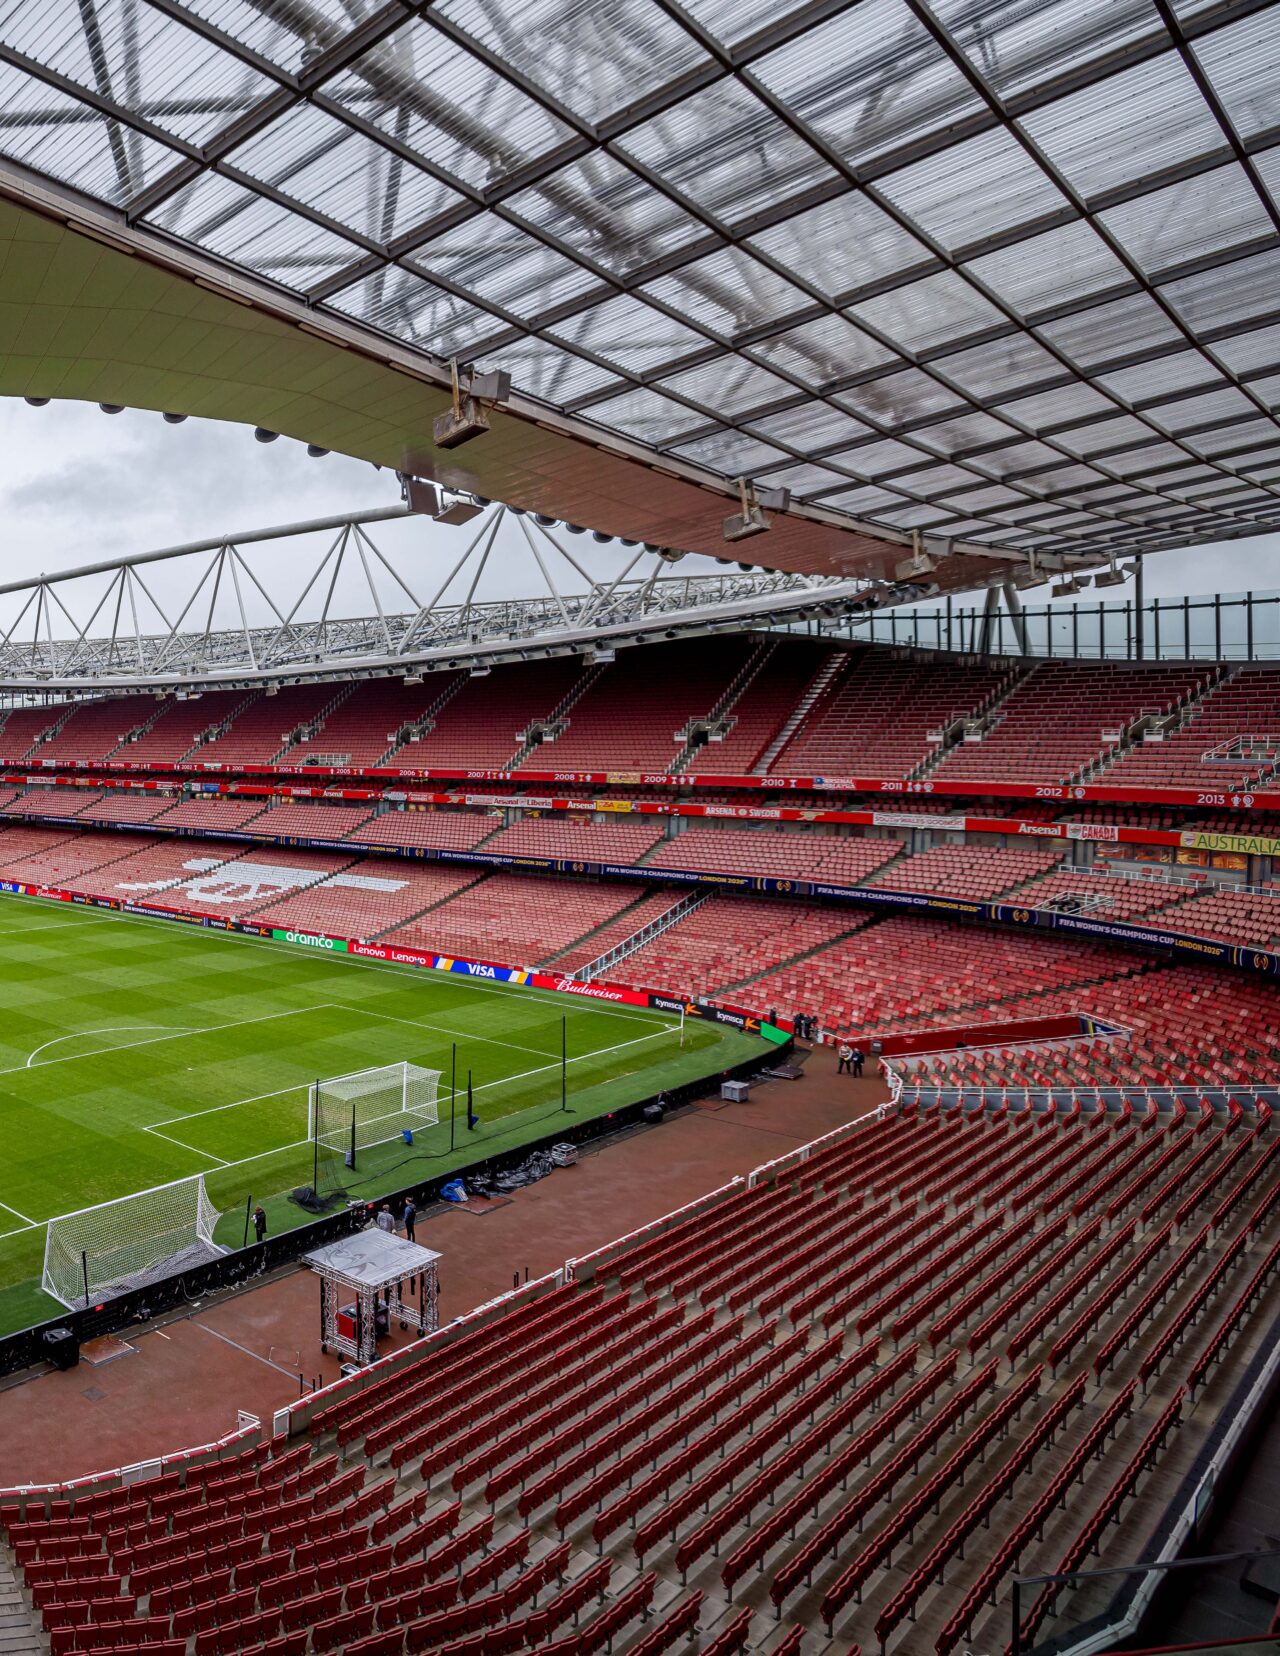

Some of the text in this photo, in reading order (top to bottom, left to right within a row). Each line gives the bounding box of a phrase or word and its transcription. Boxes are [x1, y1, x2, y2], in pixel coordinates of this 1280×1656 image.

[644, 775, 667, 783] 2009
[761, 779, 785, 787] 2010
[880, 782, 903, 790] 2011
[1035, 787, 1063, 796] 2012
[322, 789, 343, 797] Arsenal
[1197, 794, 1225, 804] 2013
[526, 799, 552, 807] Liberia
[567, 801, 596, 810] Arsenal
[705, 807, 780, 818] ARSENAL SWEDEN
[1018, 823, 1061, 836] Arsenal
[1080, 826, 1116, 840] CANADA
[1197, 834, 1280, 854] AUSTRALIA
[620, 867, 647, 876] WOMEN'S
[648, 870, 685, 879] CHAMPIONS
[685, 873, 699, 881] CUP
[699, 875, 727, 883] LONDON
[1, 882, 13, 891] VISA
[817, 887, 833, 895] FIFA
[833, 888, 867, 898] WOMEN'S
[867, 891, 913, 904] CHAMPIONS
[913, 897, 928, 905] CUP
[928, 899, 959, 910] LONDON
[285, 932, 333, 949] aramco
[1058, 918, 1075, 928] FIFA
[1075, 921, 1110, 934] WOMEN'S
[1111, 927, 1158, 942] CHAMPIONS
[1159, 935, 1175, 945] CUP
[1174, 938, 1202, 952] LONDON
[353, 944, 386, 958] Lenovo
[391, 951, 426, 965] Lenovo
[466, 962, 495, 978] VISA
[553, 978, 624, 1000] Budweiser
[655, 998, 683, 1010] kynisca
[716, 1011, 744, 1025] kynisca
